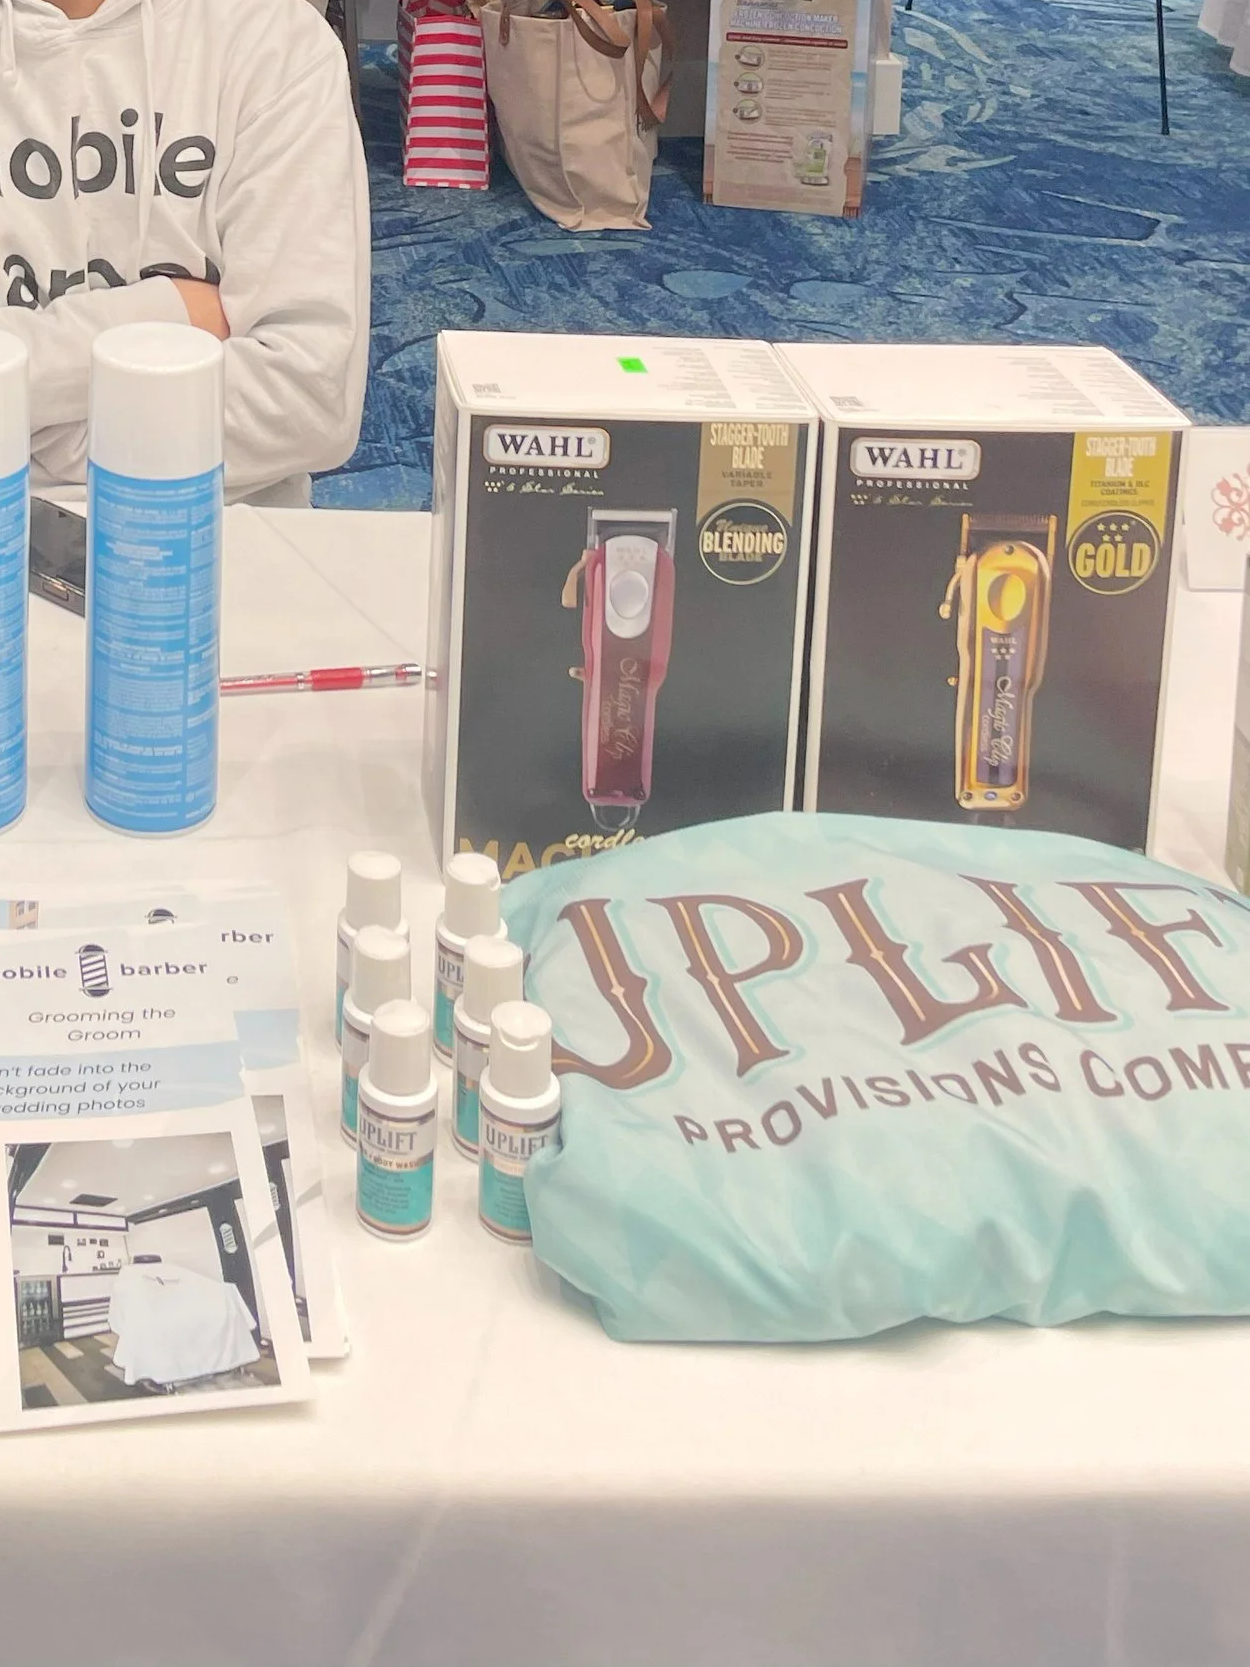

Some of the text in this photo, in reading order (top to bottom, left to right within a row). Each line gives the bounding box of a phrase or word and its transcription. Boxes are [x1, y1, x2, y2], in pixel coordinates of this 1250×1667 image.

[497, 433, 593, 458] WAHL
[710, 423, 789, 447] STAGGER-TOOTH
[731, 446, 764, 469] BLADE
[864, 446, 963, 470] WAHL
[489, 465, 599, 479] PROFESSIONAL
[856, 479, 969, 491] PROFESSIONAL
[702, 530, 785, 555] BLENDING
[1075, 542, 1152, 579] GOLD
[221, 929, 274, 944] rber
[119, 961, 209, 977] barber
[438, 954, 464, 983] UPL
[524, 873, 1250, 1091] UPLIF
[28, 1006, 176, 1024] Grooming the
[67, 1027, 141, 1042] Groom
[27, 1063, 72, 1078] fade
[78, 1061, 115, 1075] into
[120, 1061, 152, 1074] the
[92, 1079, 111, 1093] of
[117, 1078, 161, 1094] your
[674, 1041, 1062, 1154] PROVISIONS
[77, 1097, 146, 1115] photos
[486, 1123, 548, 1155] UPLIFT
